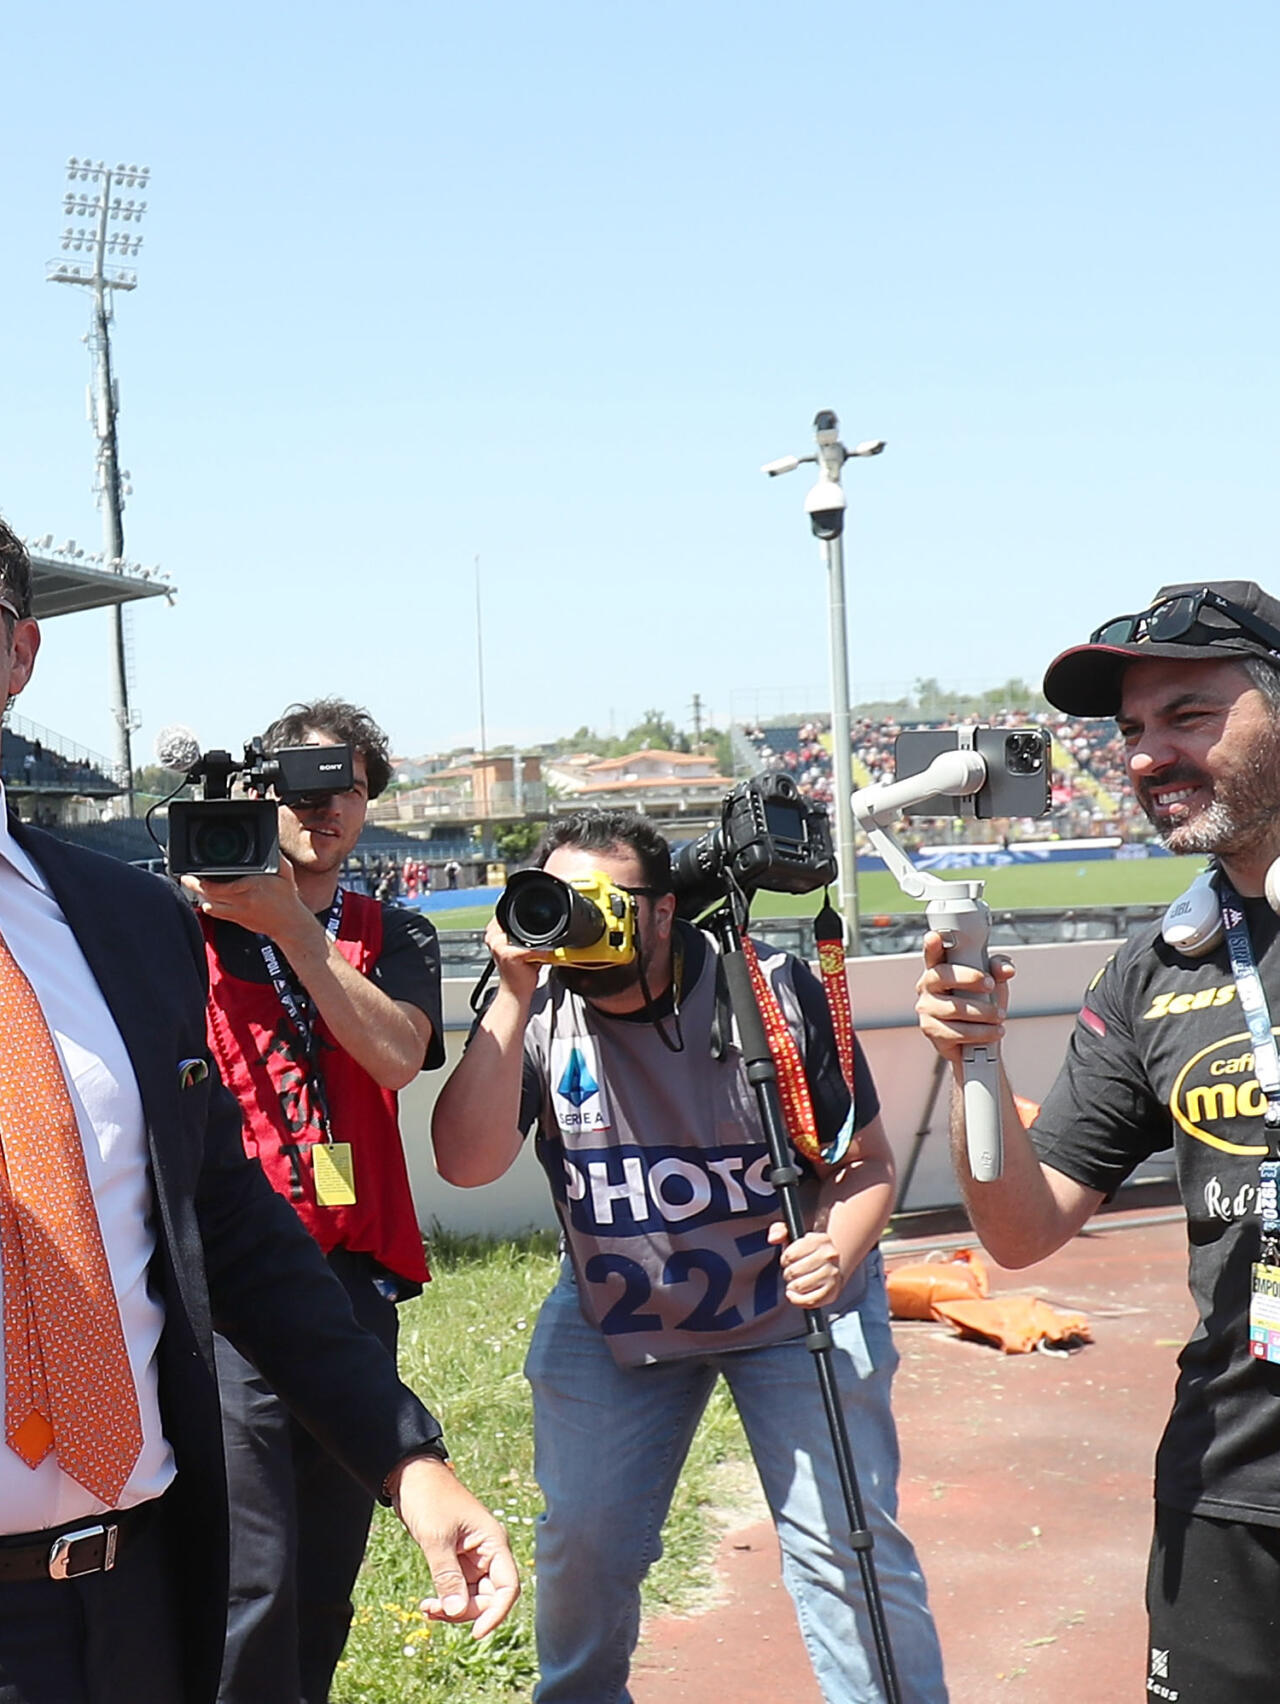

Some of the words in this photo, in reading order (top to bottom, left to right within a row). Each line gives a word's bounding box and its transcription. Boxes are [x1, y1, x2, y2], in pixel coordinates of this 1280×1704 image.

[319, 763, 342, 771] SONY
[1170, 901, 1192, 918] JBL
[261, 945, 281, 976] EMPOLI
[1143, 984, 1237, 1020] Zeus
[1186, 1080, 1269, 1124] mo
[559, 1112, 591, 1126] SERIE
[596, 1112, 604, 1123] A
[1261, 1179, 1279, 1220] 1920
[585, 1228, 792, 1335] 227
[1253, 1277, 1280, 1299] EMPO
[1146, 1677, 1179, 1701] Zeus
